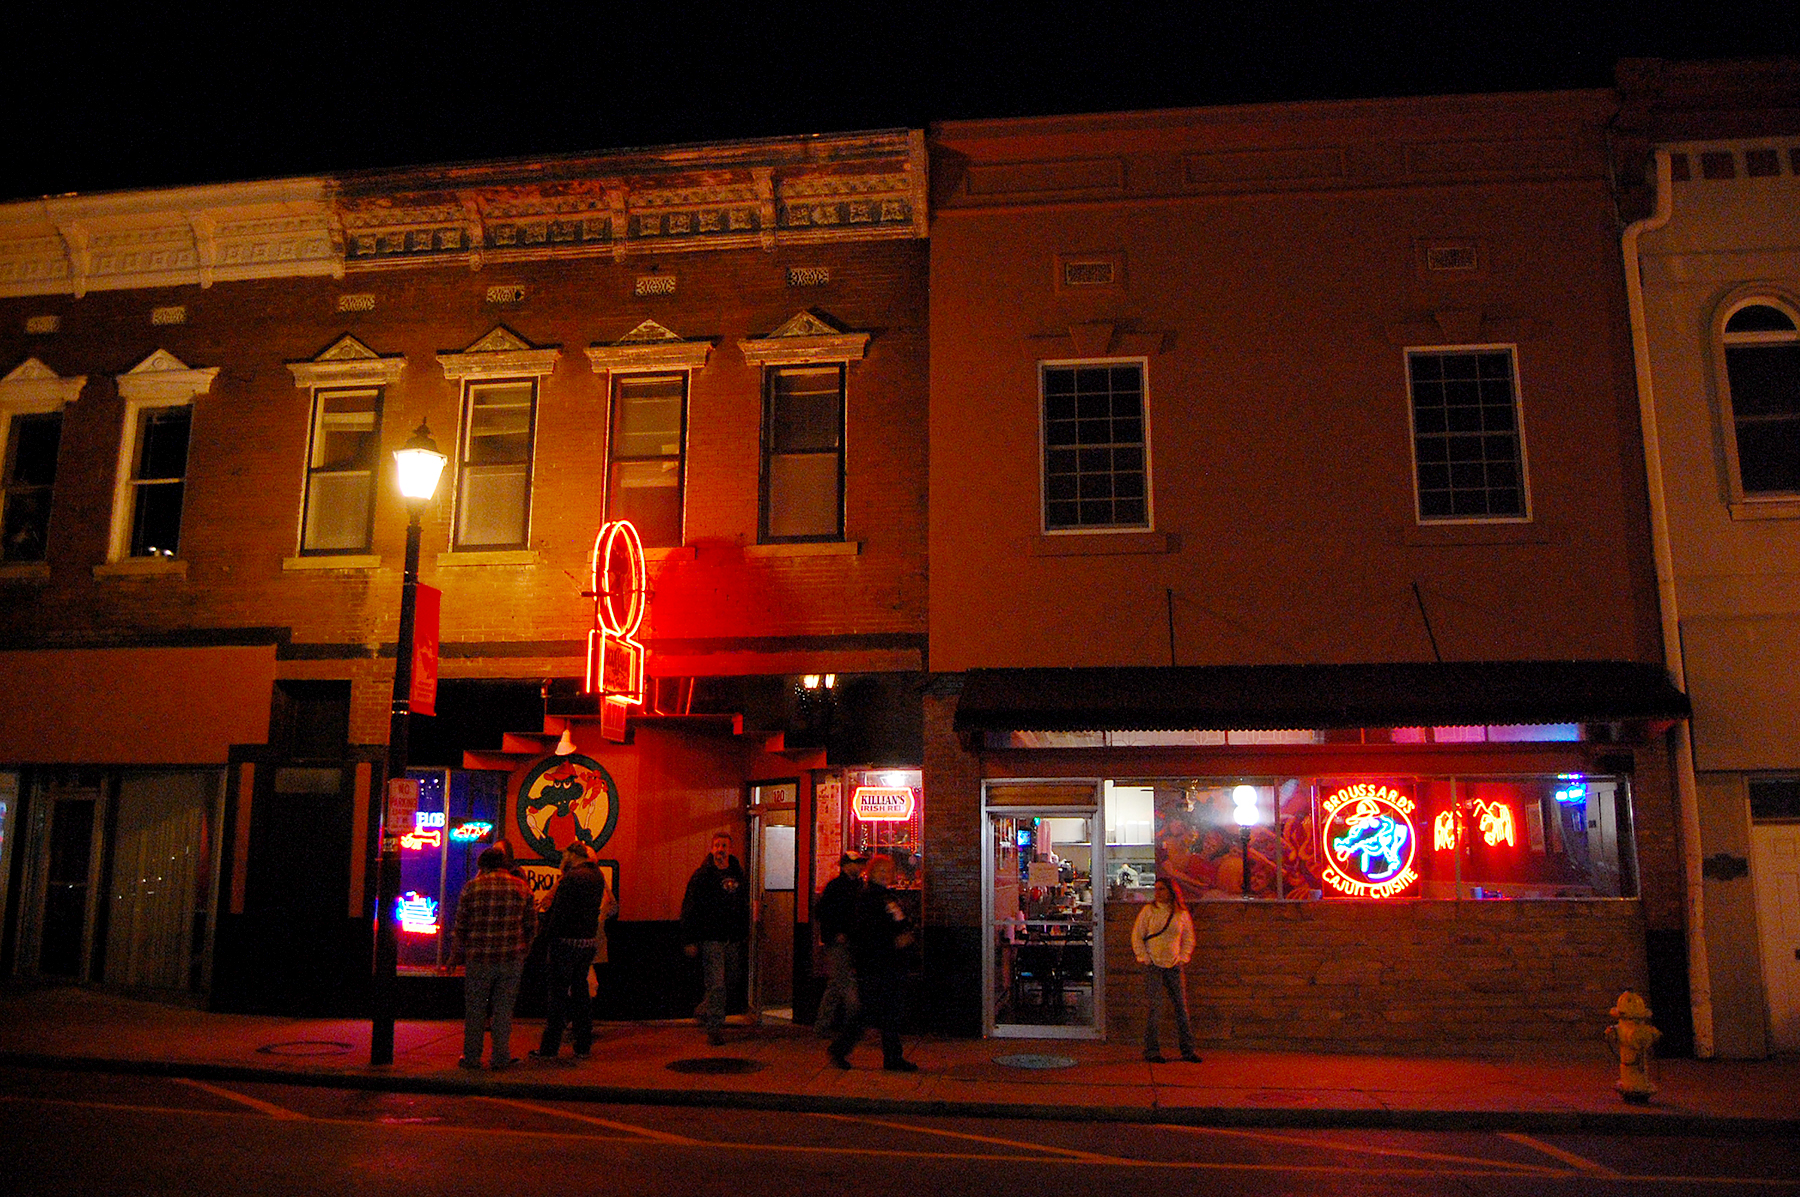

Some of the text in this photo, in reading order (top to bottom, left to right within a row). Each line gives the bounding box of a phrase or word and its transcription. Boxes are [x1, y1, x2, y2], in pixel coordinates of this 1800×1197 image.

[398, 783, 410, 795] NO
[861, 794, 905, 805] KILLIAN'S
[1323, 783, 1416, 815] BROUSSARDS
[453, 822, 491, 839] ATM
[1321, 867, 1419, 900] CAJUN CUISINE
